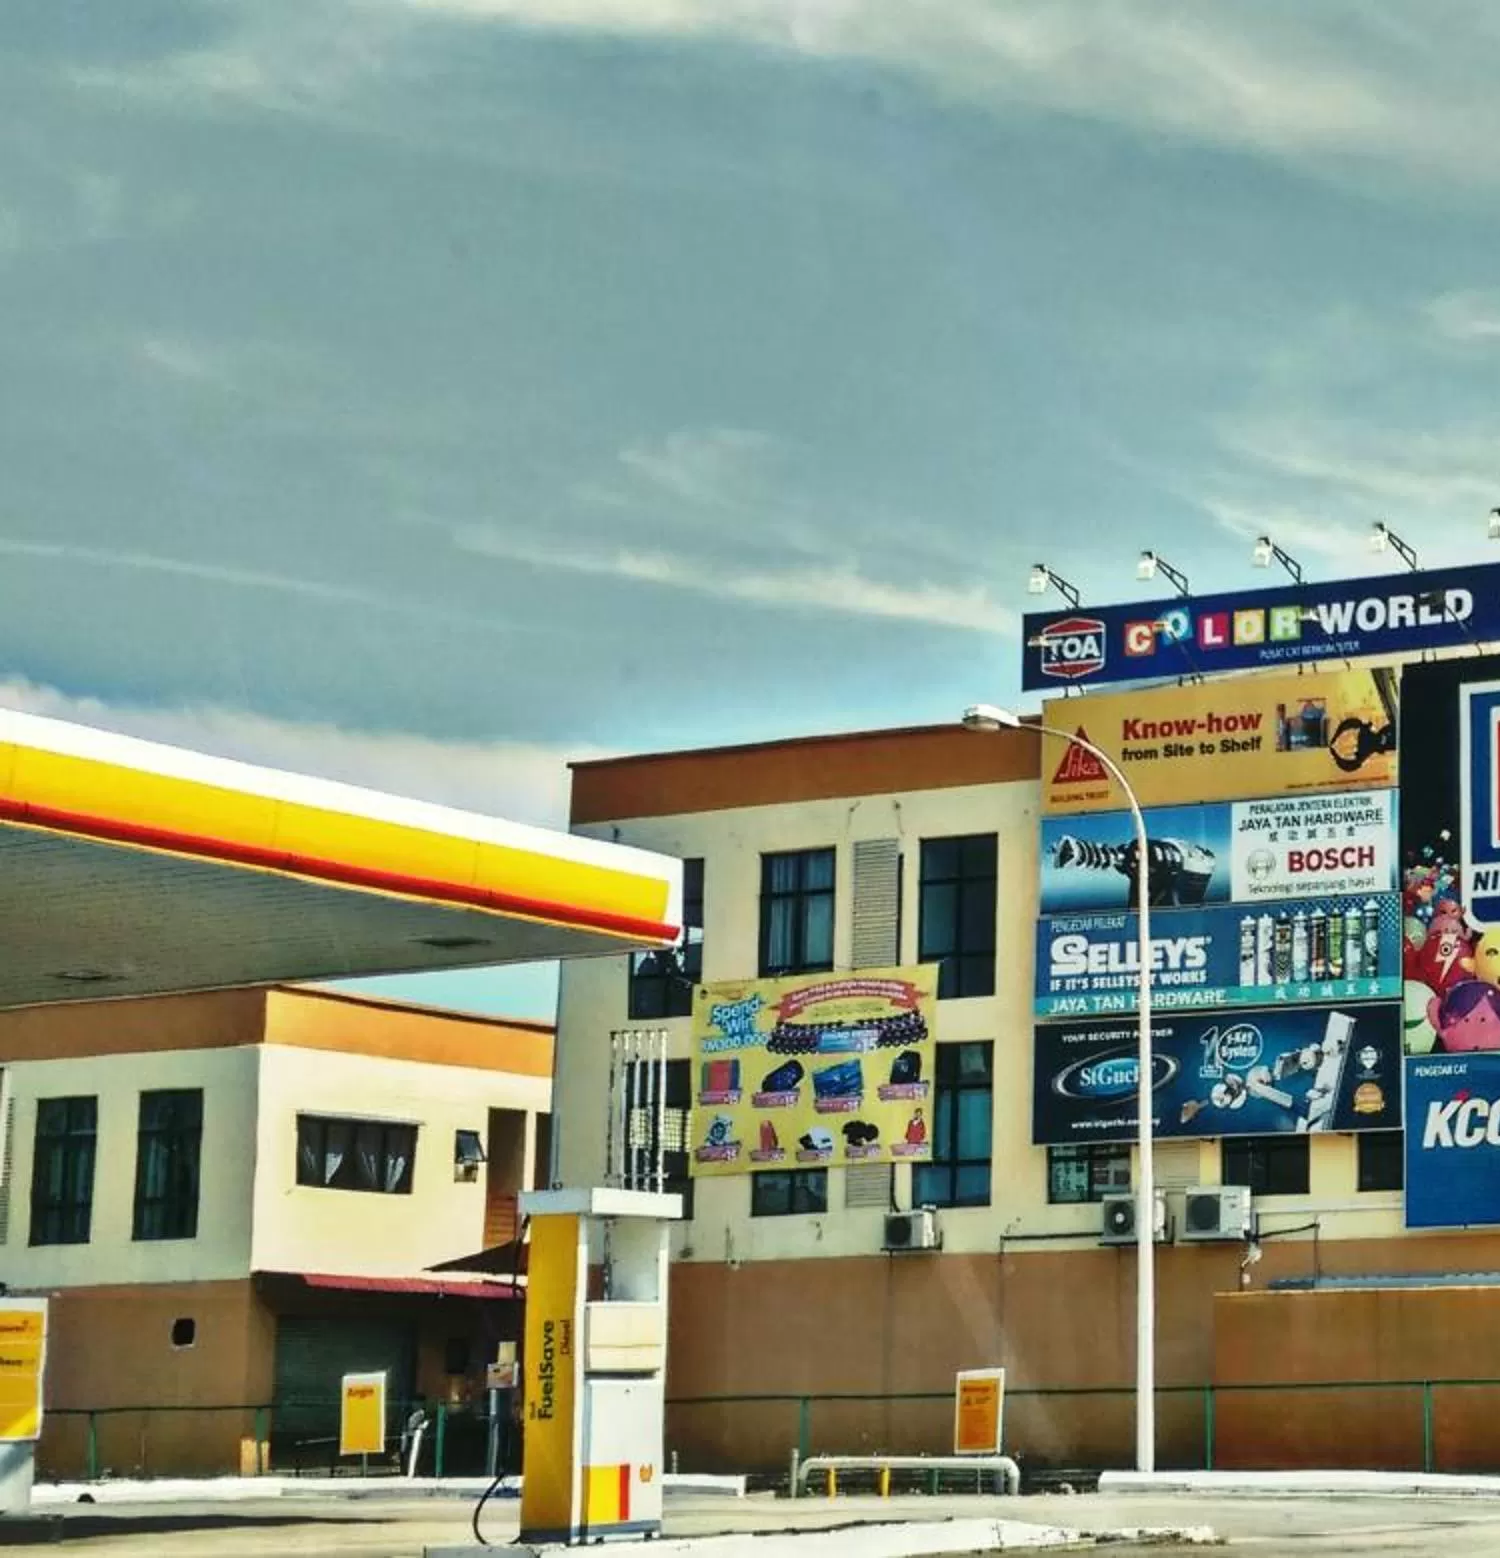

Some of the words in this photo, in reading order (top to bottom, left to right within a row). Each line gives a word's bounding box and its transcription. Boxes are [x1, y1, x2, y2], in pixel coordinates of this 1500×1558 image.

[1127, 608, 1300, 653] COLOR
[1318, 588, 1473, 635] WORLD
[1051, 637, 1101, 662] TOA
[1122, 711, 1262, 741] Know-how
[1059, 745, 1100, 778] Sika
[1122, 746, 1159, 761] from
[1163, 743, 1194, 758] Site
[1199, 741, 1215, 756] to
[1220, 736, 1262, 753] Shelf
[1238, 815, 1272, 832] JAYA
[1275, 813, 1301, 829] TAN
[1304, 808, 1384, 827] HARDWARE
[1288, 845, 1375, 873] BOSCH
[1051, 934, 1207, 976] SELLEYS
[1051, 979, 1062, 992] IF
[1066, 977, 1089, 991] IT'S
[1092, 974, 1141, 989] SELLEYS
[1159, 969, 1206, 984] WORKS
[1051, 997, 1088, 1013] JAYA
[1093, 995, 1125, 1011] TAN
[1131, 989, 1227, 1009] HRDWARE
[1088, 1030, 1131, 1041] SECURITY
[1133, 1028, 1173, 1039] PTNER
[537, 1320, 555, 1420] FuelSave
